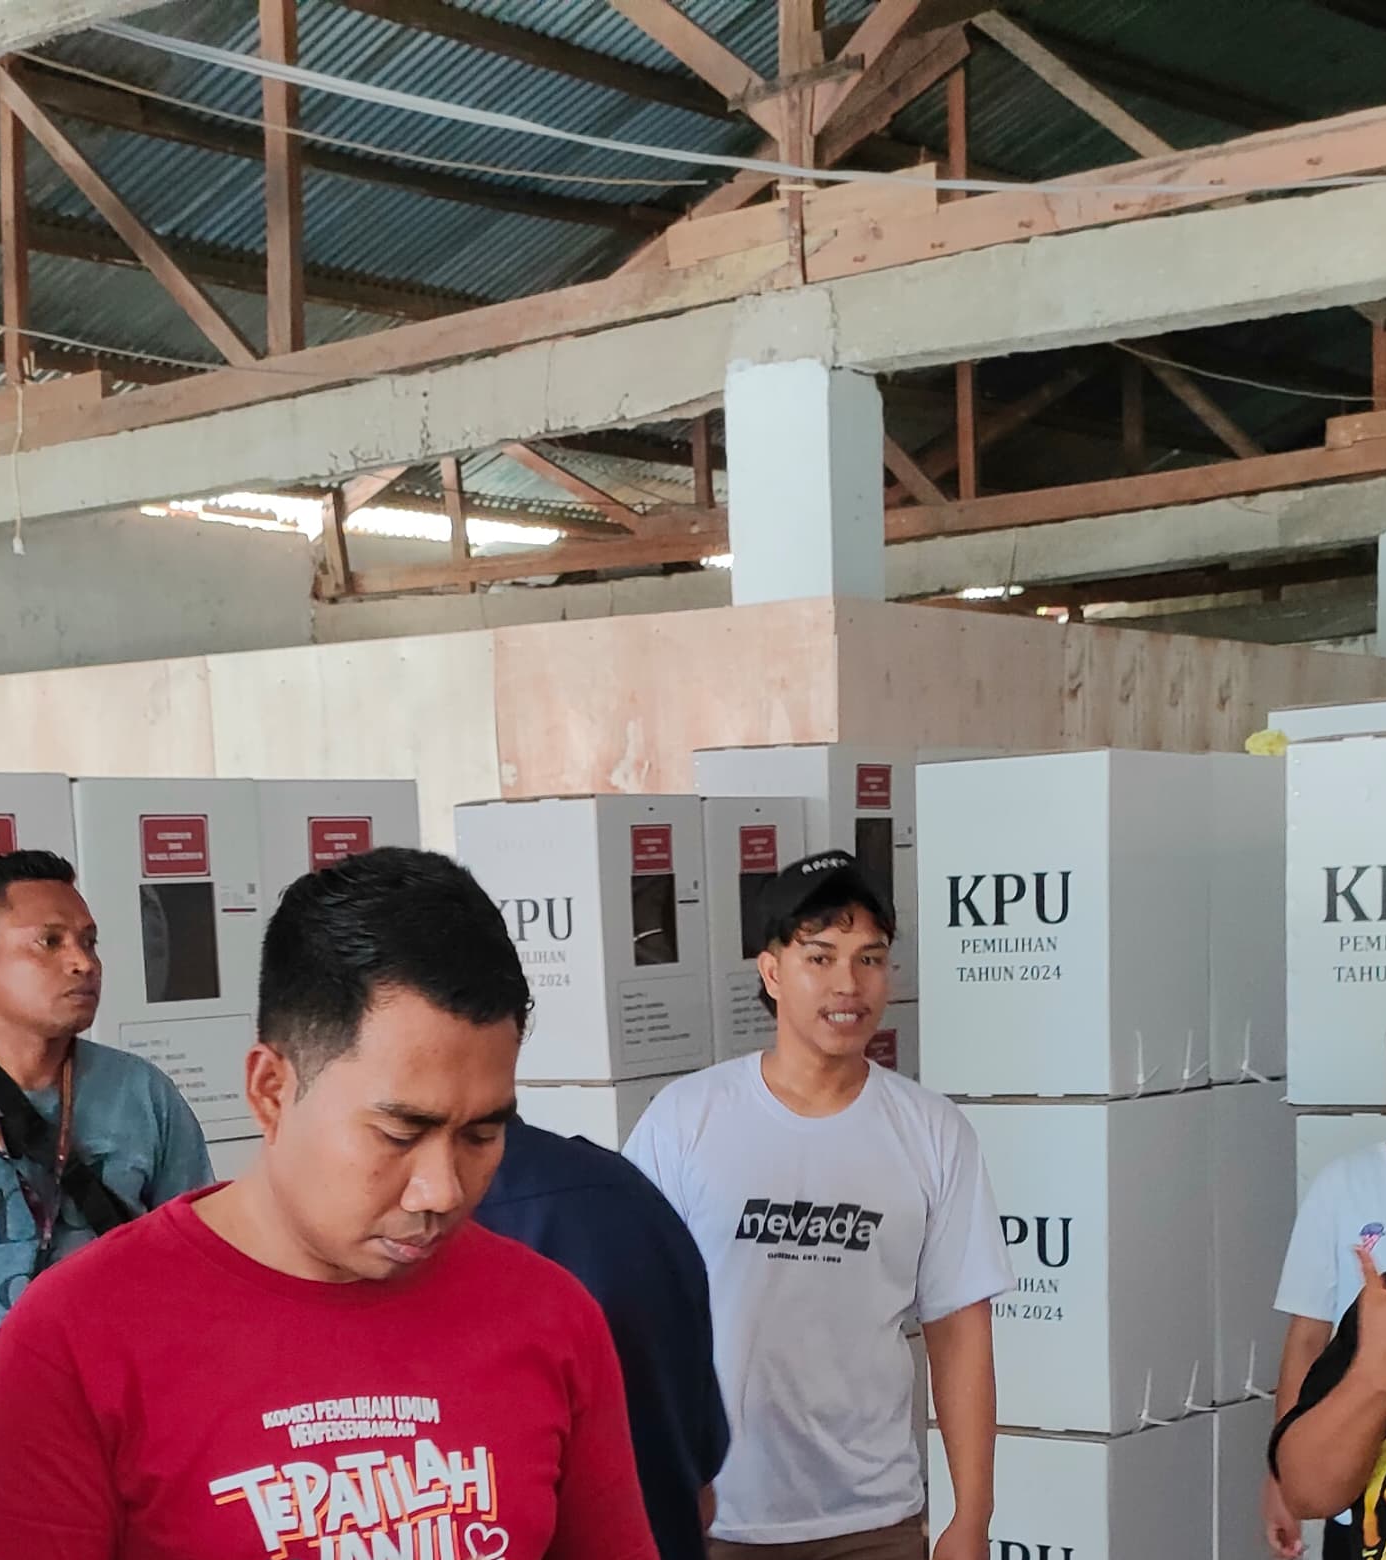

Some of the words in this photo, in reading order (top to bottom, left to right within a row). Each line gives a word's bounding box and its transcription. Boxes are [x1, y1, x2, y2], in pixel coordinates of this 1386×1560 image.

[946, 870, 1072, 928] KPU
[960, 936, 1059, 955] PEMILIHAN
[956, 965, 1015, 983] TAHUN
[1019, 964, 1062, 981] 2024
[739, 1206, 880, 1245] nevada
[1022, 1304, 1064, 1321] 2024
[262, 1402, 315, 1430] KOMISI
[315, 1396, 393, 1421] PEMILIHAN
[393, 1395, 441, 1424] UMUM
[209, 1438, 493, 1555] TEPATILAH
